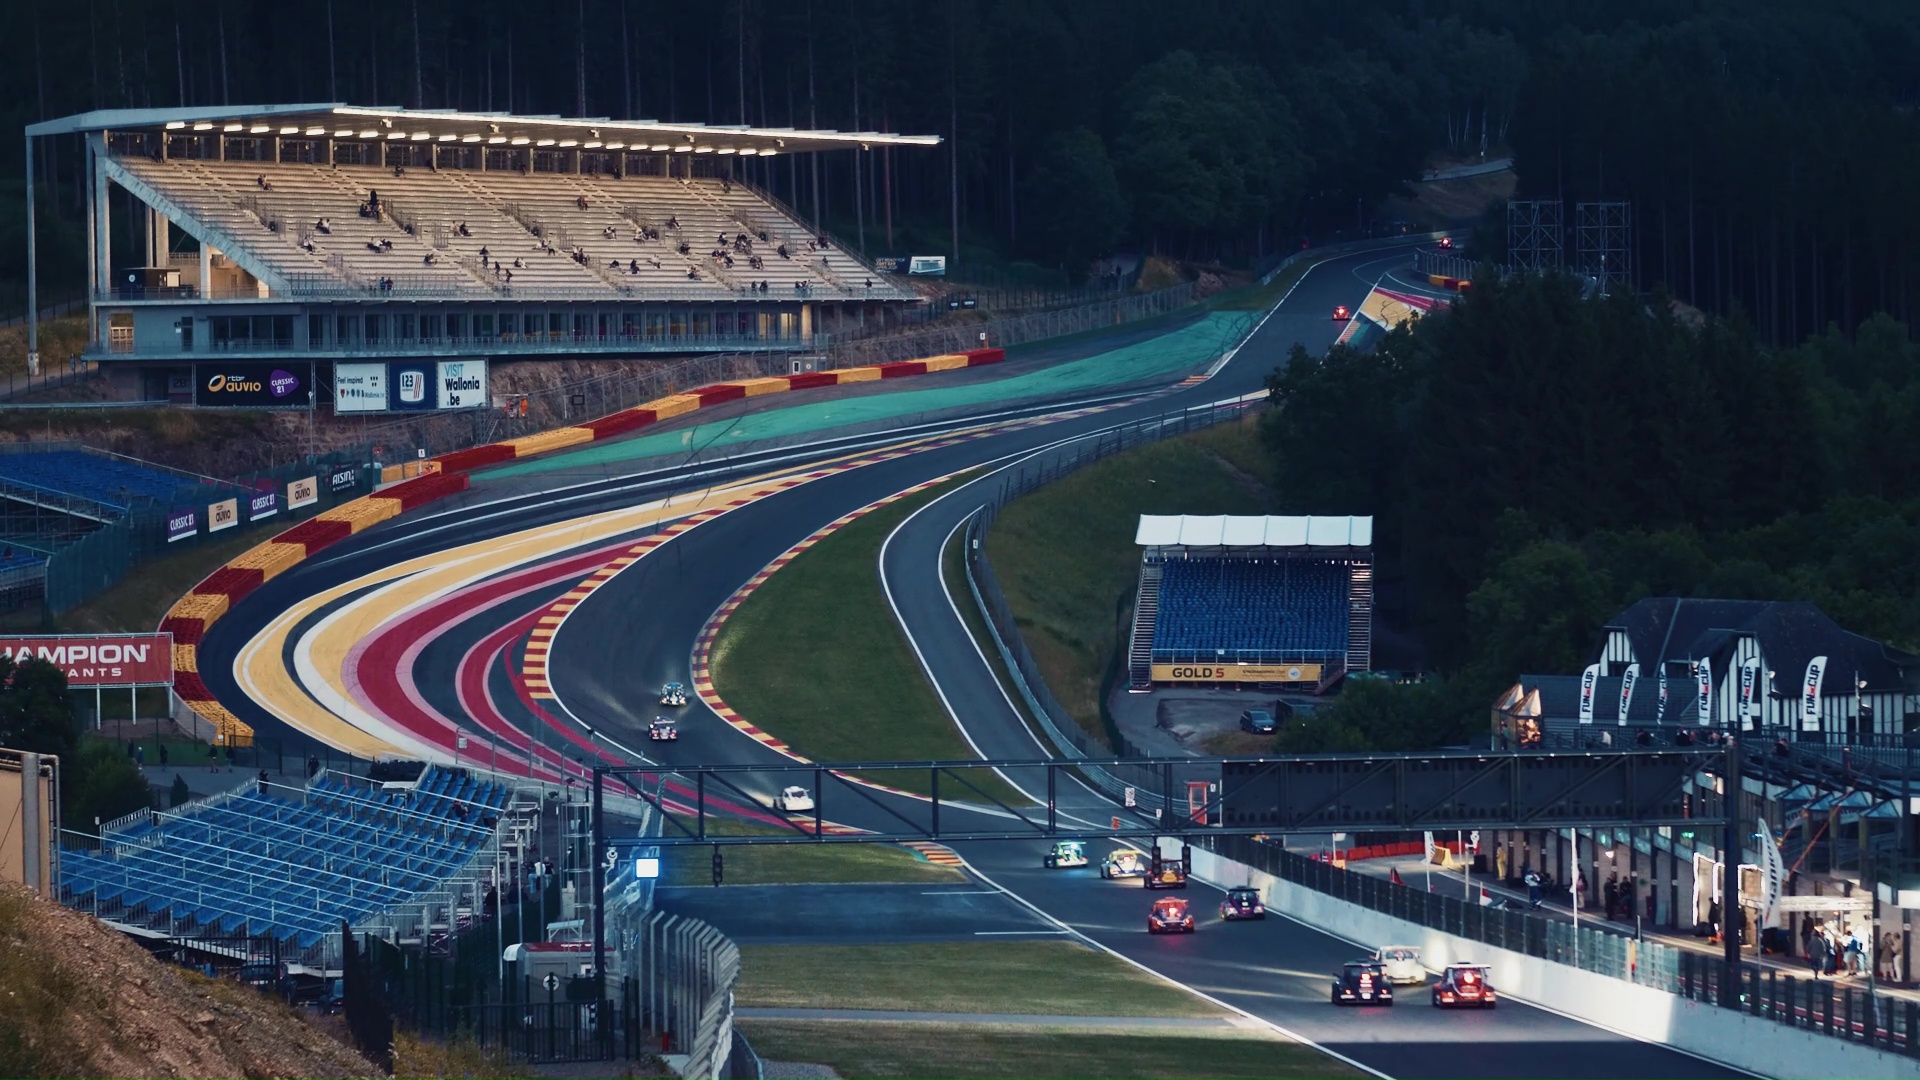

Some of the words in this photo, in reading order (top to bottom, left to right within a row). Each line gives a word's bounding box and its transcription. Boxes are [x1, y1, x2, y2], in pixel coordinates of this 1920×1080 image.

[444, 364, 464, 377] VISIT
[271, 377, 294, 387] CLASSIC
[402, 375, 414, 388] 123
[445, 376, 480, 391] Wallonia
[276, 386, 285, 394] 21
[252, 496, 269, 511] CLASSIC
[170, 516, 188, 531] CLASSIC
[1172, 667, 1212, 678] GOLD
[1585, 671, 1594, 689] CUP
[1700, 666, 1709, 685] CUP
[1743, 666, 1754, 688] CUP
[1807, 664, 1820, 687] CUP
[1620, 696, 1628, 714] FUN
[1624, 670, 1634, 689] CUP
[1582, 696, 1591, 713] FUN
[1700, 693, 1709, 711] FUN
[1806, 694, 1816, 715] FUN
